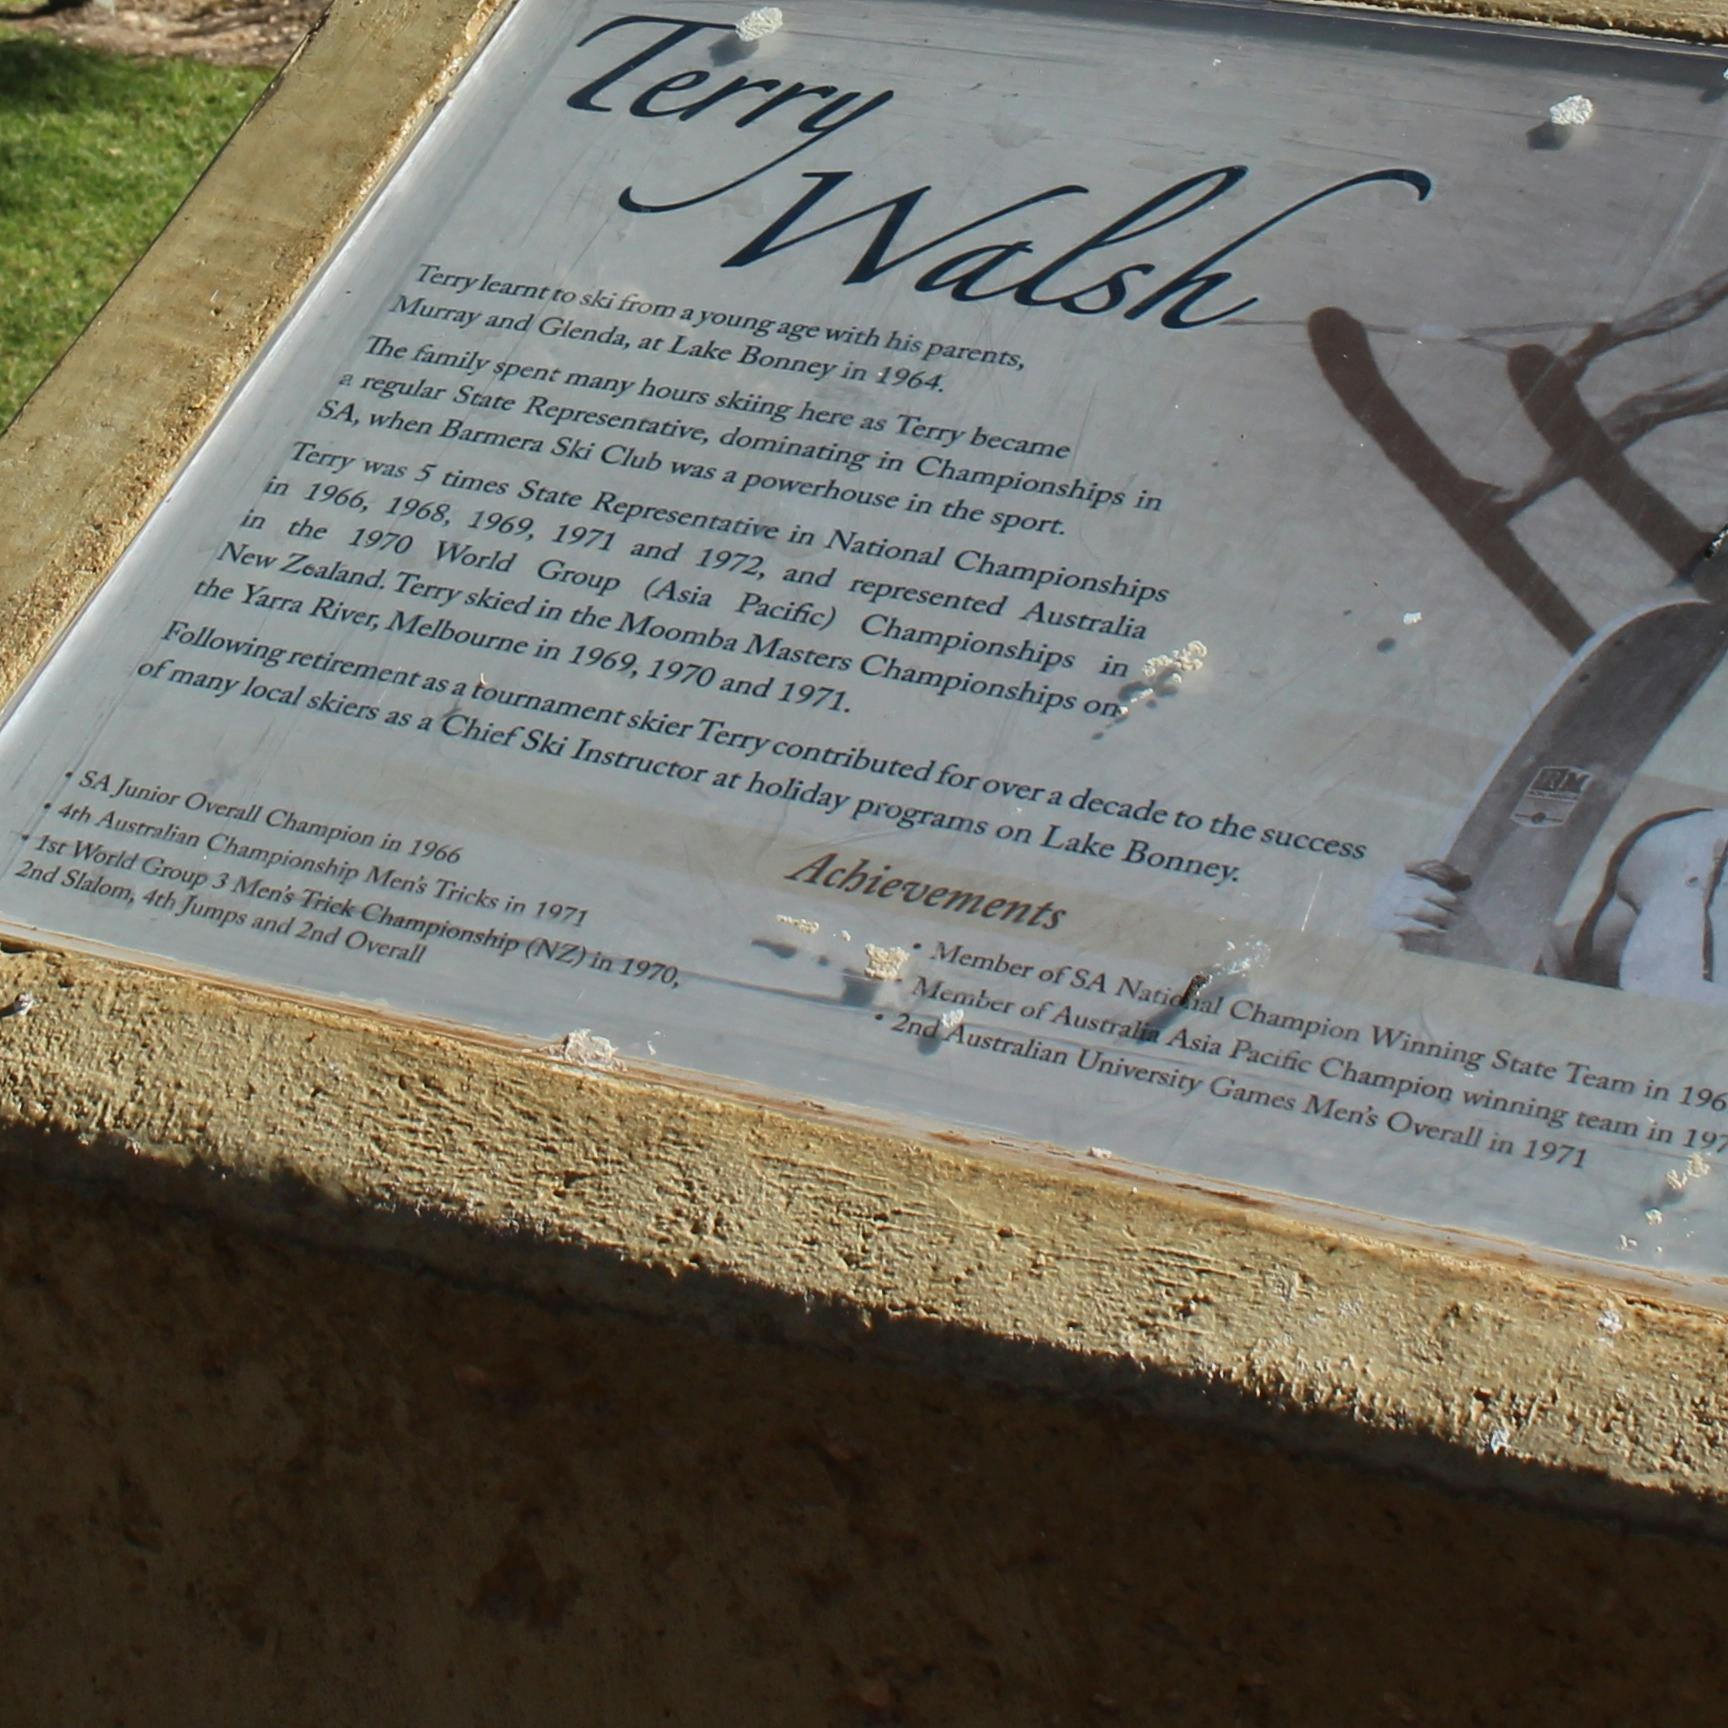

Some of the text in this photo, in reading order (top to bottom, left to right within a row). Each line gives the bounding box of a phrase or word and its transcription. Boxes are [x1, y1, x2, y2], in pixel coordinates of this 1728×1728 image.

[566, 15, 894, 213] Terry
[417, 263, 1025, 371] Terry learnt to ski from a young age with his parents,
[720, 165, 1432, 330] Walsh
[365, 335, 1071, 459] The family spent many hours skiing here as Terry became
[389, 295, 943, 393] Murray and Glenda, at Lake Bonney in 1964.
[317, 399, 1065, 536] SA, when Barmera Ski Club was a powerhouse in the sport.
[338, 374, 1162, 511] a regular State Representative, dominating in Championships in
[239, 508, 1129, 678] in the 1970 World Group (Asia Pacific) Championships in
[263, 475, 1147, 640] in 1966, 1968, 1969, 1971 and 1972, and represented Australia
[292, 441, 1170, 607] Terry was 5 times State Representative in National Championships
[193, 577, 850, 713] the Yarra River, Melbourne in 1969, 1970 and 1971.
[216, 541, 1119, 718] New Zealand. Terry skied in the Moomba Masters Championships on
[137, 659, 1239, 887] of many local skiers as a Chief Ski Instructor at holiday programs on Lake Bonney.
[161, 620, 1367, 860] Following retirement as a tournament skier Terry contributed for over a decade to the success
[58, 803, 588, 927] 4th Australian Championship Men's Tricks in 1971
[78, 770, 462, 864] SA Junior Overall Champion in 1966
[784, 851, 1057, 931] Achievements
[891, 1012, 1587, 1169] 2nd Australian University Games Men's Overall in 1971
